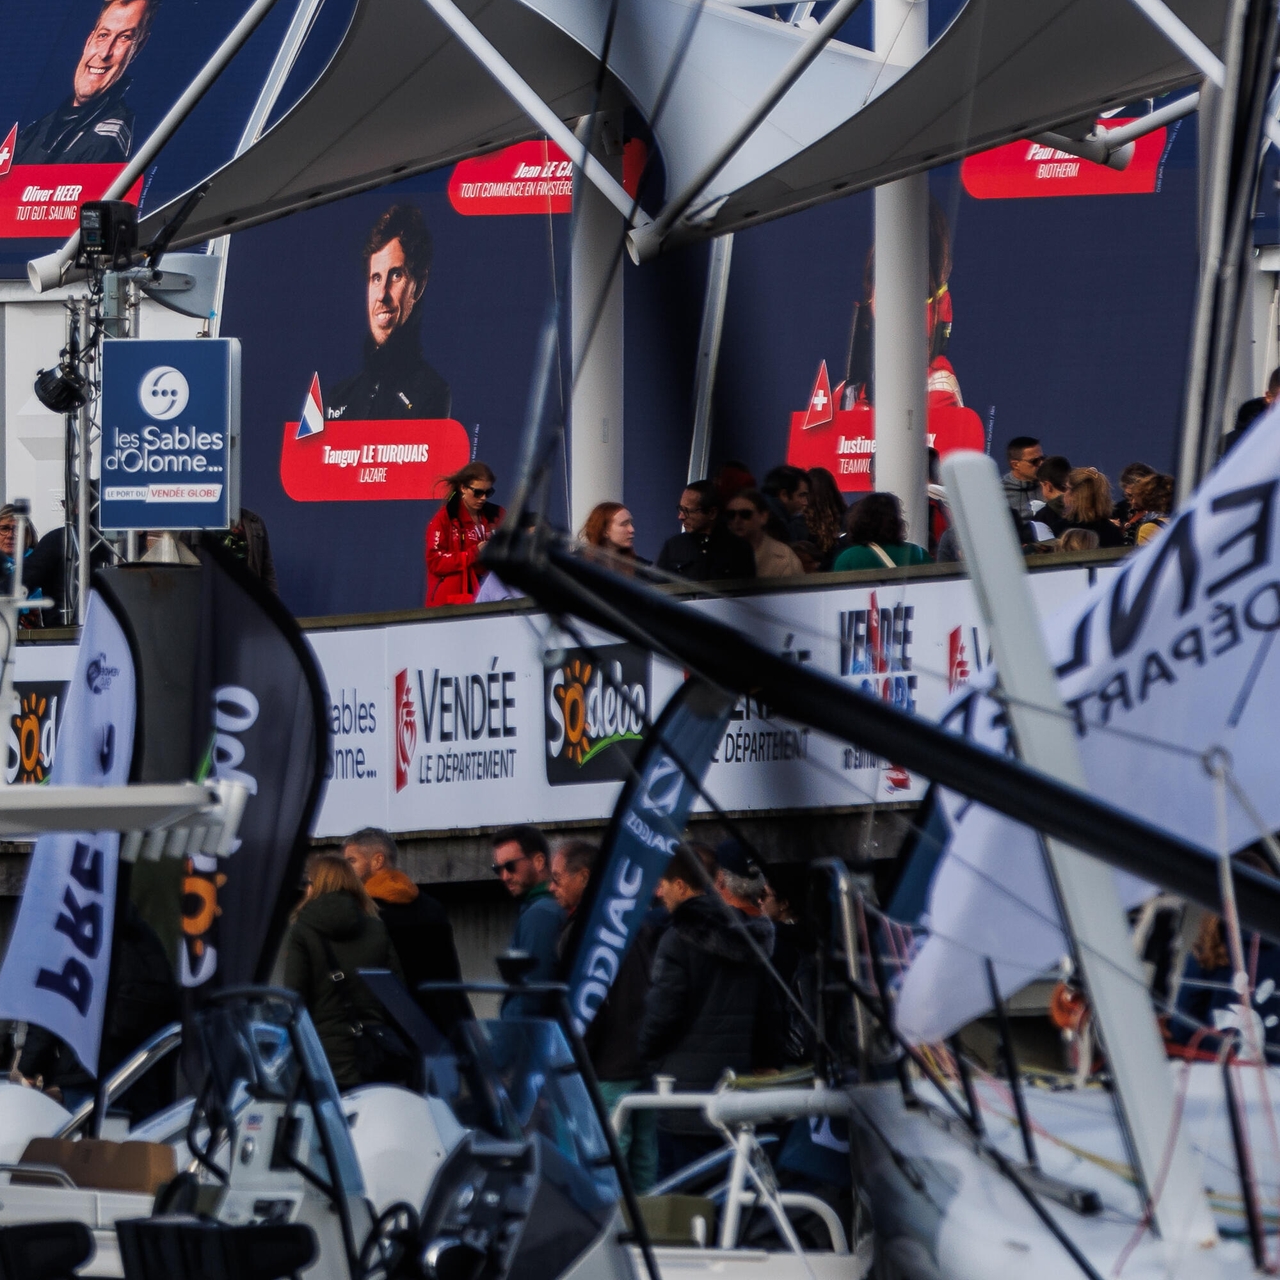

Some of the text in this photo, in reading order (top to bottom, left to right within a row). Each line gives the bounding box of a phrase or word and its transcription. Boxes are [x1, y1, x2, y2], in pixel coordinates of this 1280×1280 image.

[1027, 144, 1053, 161] Paul
[515, 162, 540, 179] Jean
[557, 161, 573, 177] CA
[1036, 163, 1080, 180] BIOTHERM
[22, 185, 83, 202] Oliver HEER
[461, 182, 482, 198] TOUT
[481, 181, 525, 197] COMMENCE
[525, 181, 535, 196] EN
[17, 205, 77, 221] TUT GUT. SAILING
[115, 425, 224, 450] les Sables
[838, 435, 876, 454] Justine
[105, 448, 223, 472] d'Olonne...
[323, 444, 429, 467] Tanguy LE TURQUAIS
[359, 467, 388, 483] LAZARE
[151, 487, 185, 498] VENDÉE
[187, 489, 218, 498] GLOBE
[417, 656, 517, 744] VENDÉE
[547, 660, 647, 759] Sodebo
[419, 748, 517, 784] LE DÉPARTEMENT
[626, 810, 681, 857] ZODIAC
